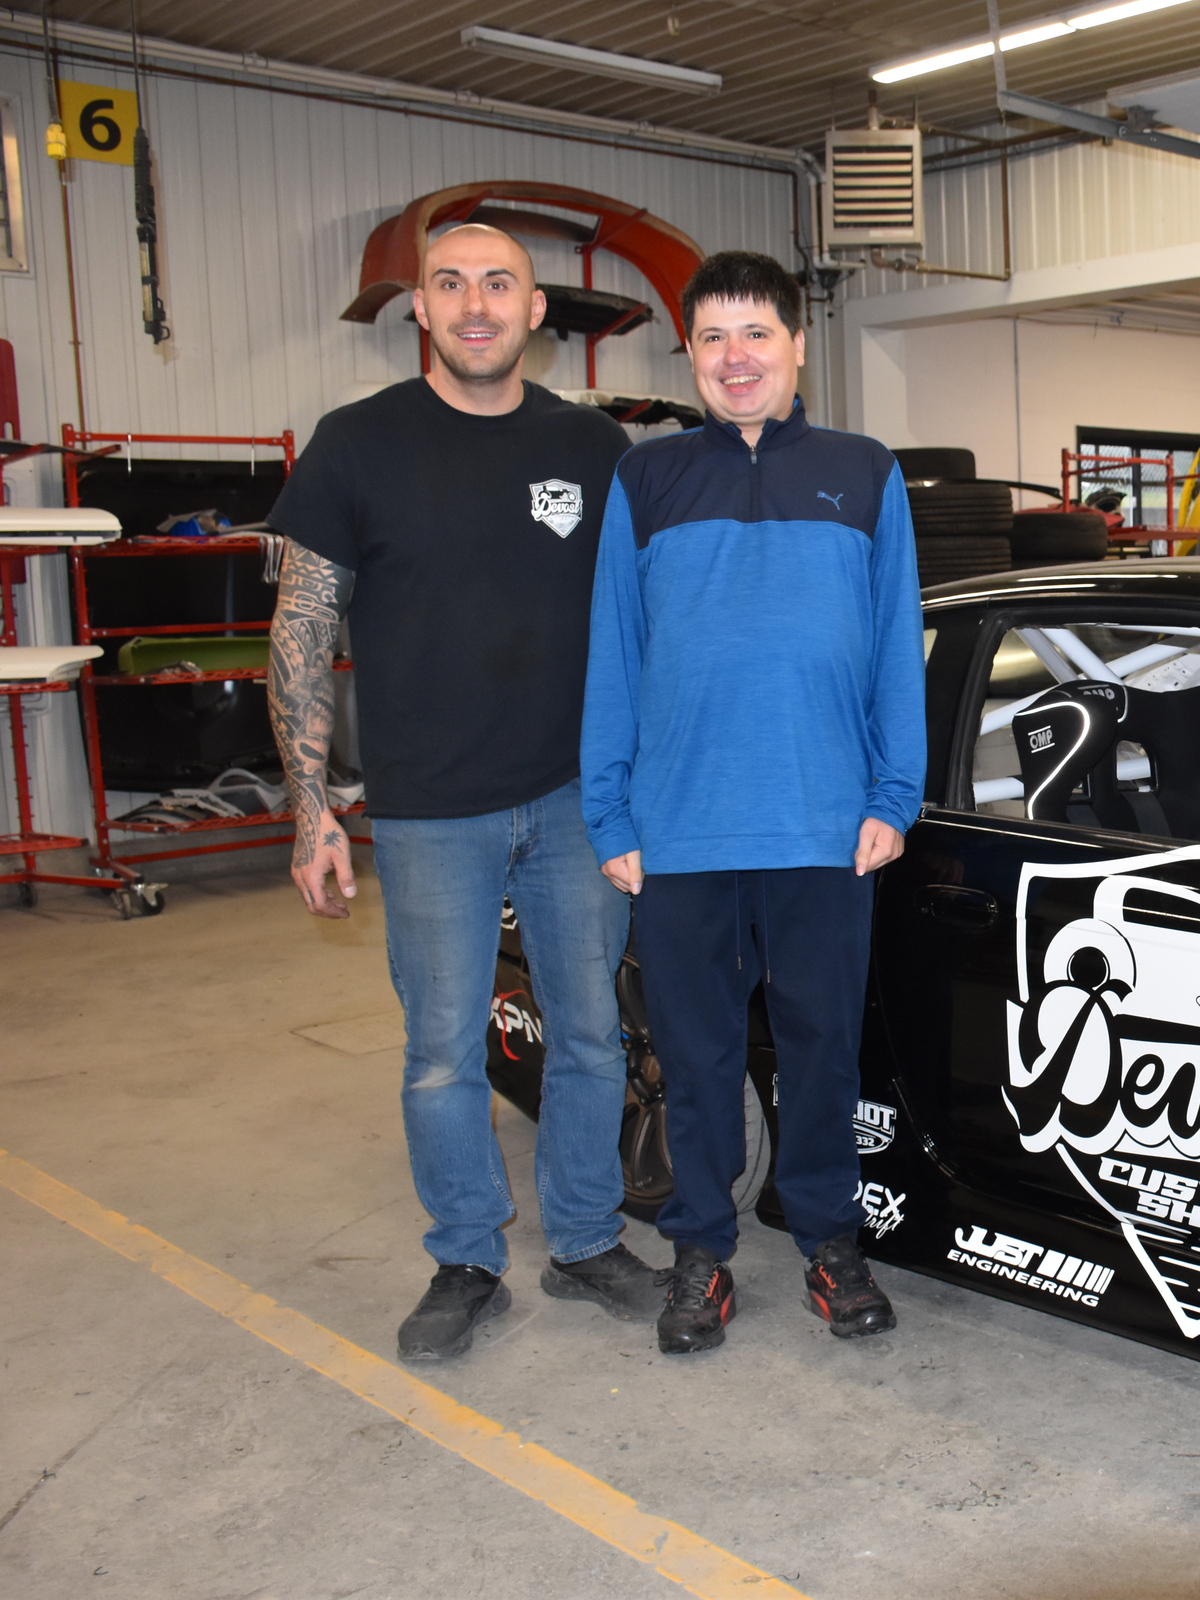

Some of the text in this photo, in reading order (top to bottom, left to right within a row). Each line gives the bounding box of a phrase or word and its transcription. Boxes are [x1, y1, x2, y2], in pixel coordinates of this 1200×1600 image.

[79, 99, 121, 152] 6
[531, 498, 583, 521] Devost
[1029, 729, 1053, 749] OMP
[954, 1225, 1044, 1269] JUST
[947, 1249, 1100, 1308] ENGINEERING
